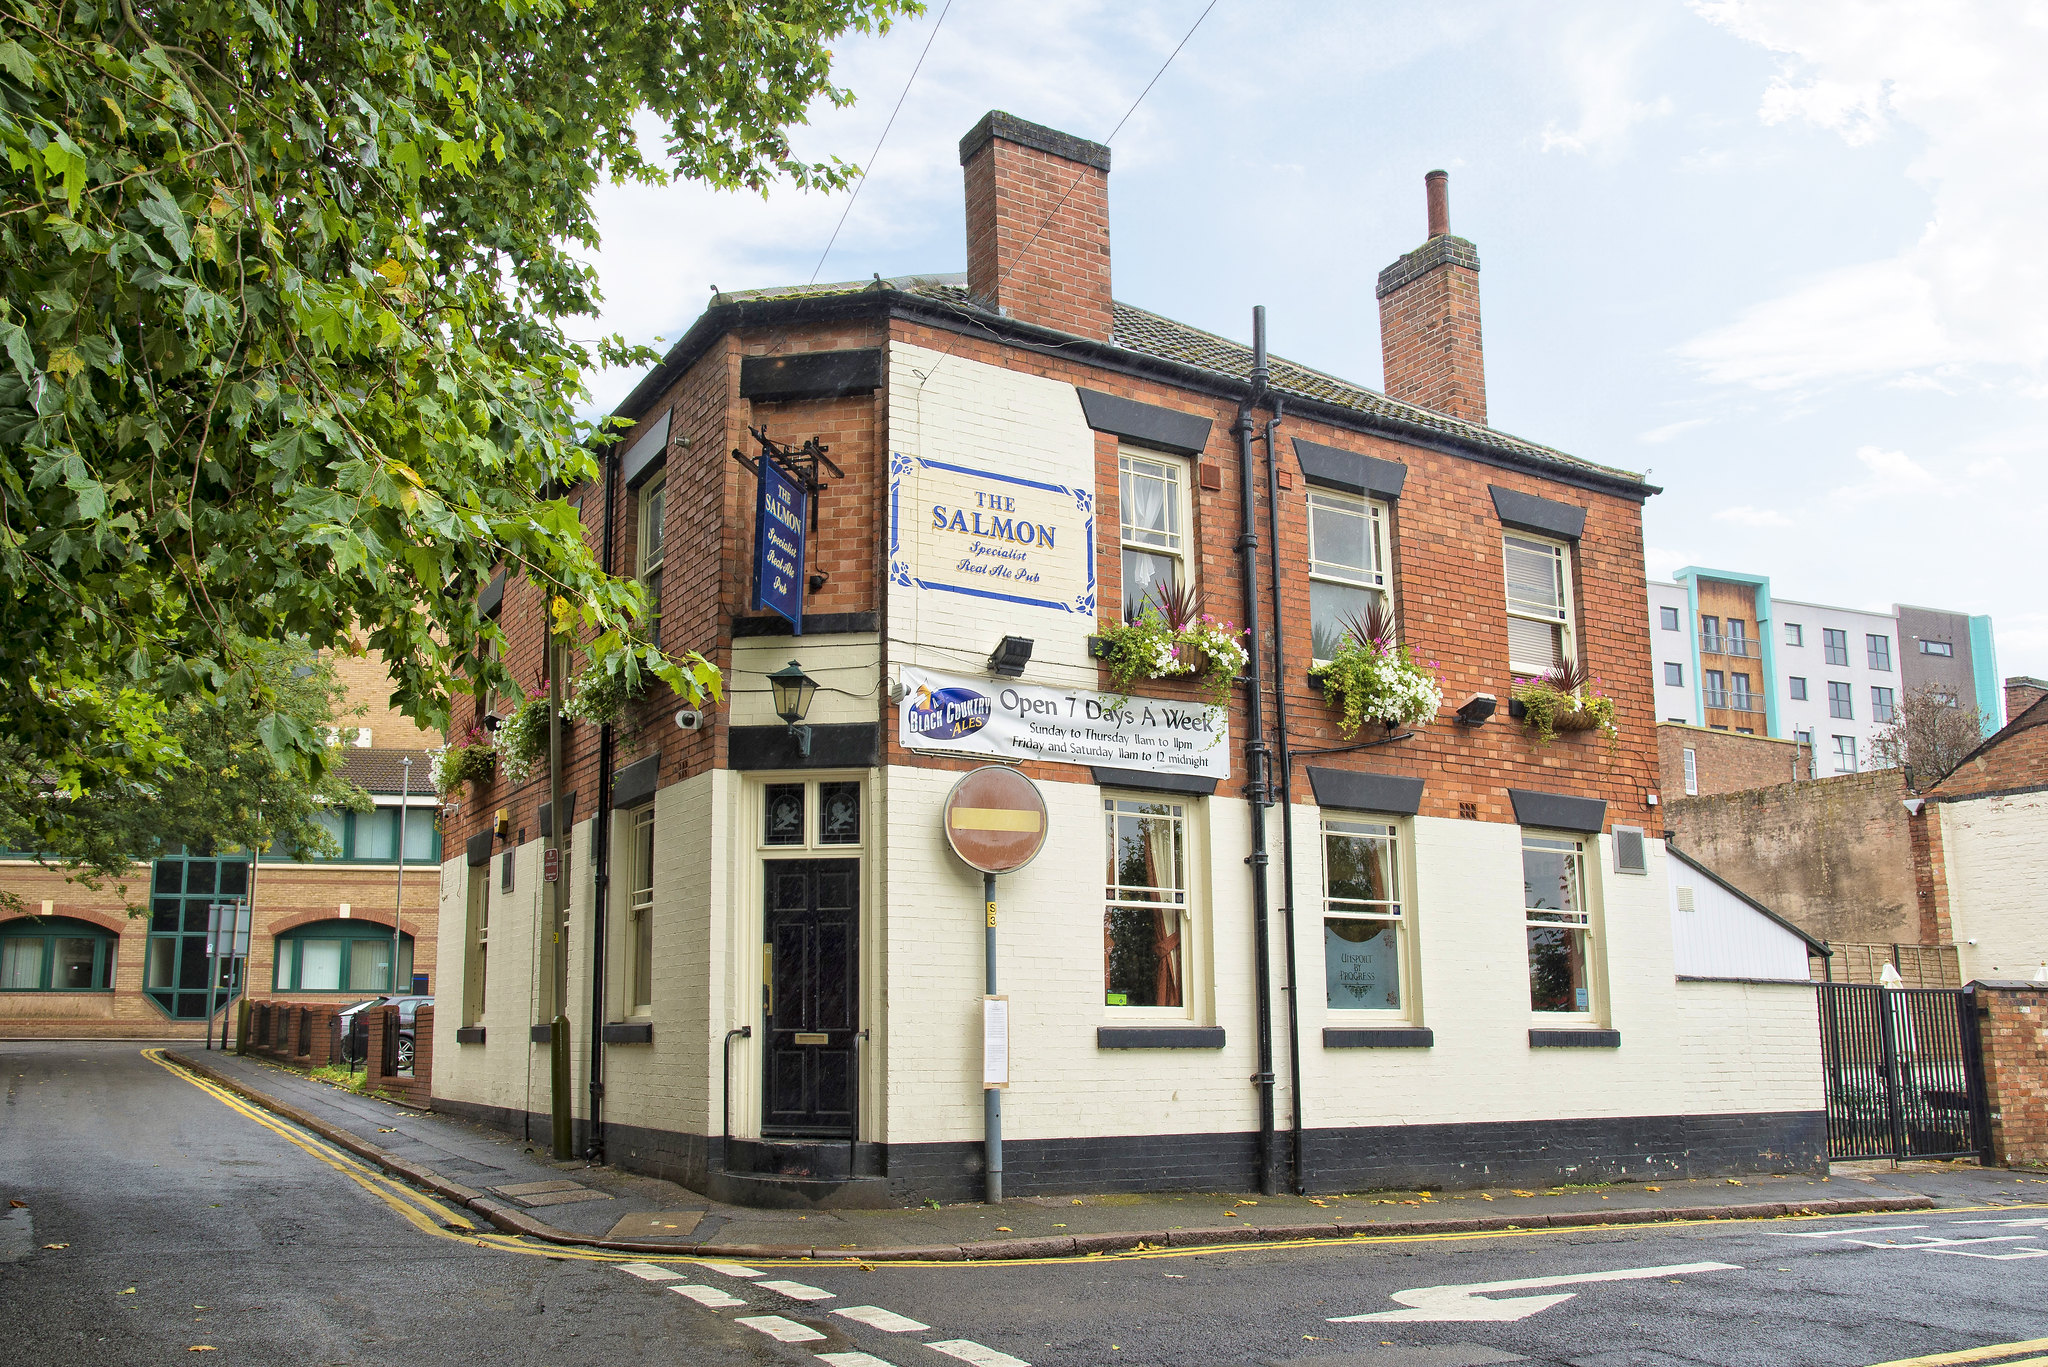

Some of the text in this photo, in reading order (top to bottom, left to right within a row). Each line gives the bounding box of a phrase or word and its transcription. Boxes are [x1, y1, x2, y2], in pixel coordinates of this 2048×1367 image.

[778, 485, 791, 505] THE
[975, 491, 1016, 512] THE
[765, 494, 801, 535] SALMON
[932, 505, 1056, 549] SALMON
[768, 528, 797, 558] Specialist
[969, 541, 1027, 561] Specialist
[767, 549, 795, 578] Real Ale
[957, 558, 1040, 583] Real Ale Pub
[773, 575, 788, 595] Pub
[910, 697, 991, 733] BLACK COUNTRY
[1000, 689, 1214, 733] Open 7 Days A Week
[952, 716, 983, 738] ALES
[1029, 722, 1193, 752] Sunday to Thursday 11am to 11pm
[1012, 736, 1209, 769] Friday and Saturday 11am to 12 midnight
[1340, 970, 1376, 981] PROGRESS
